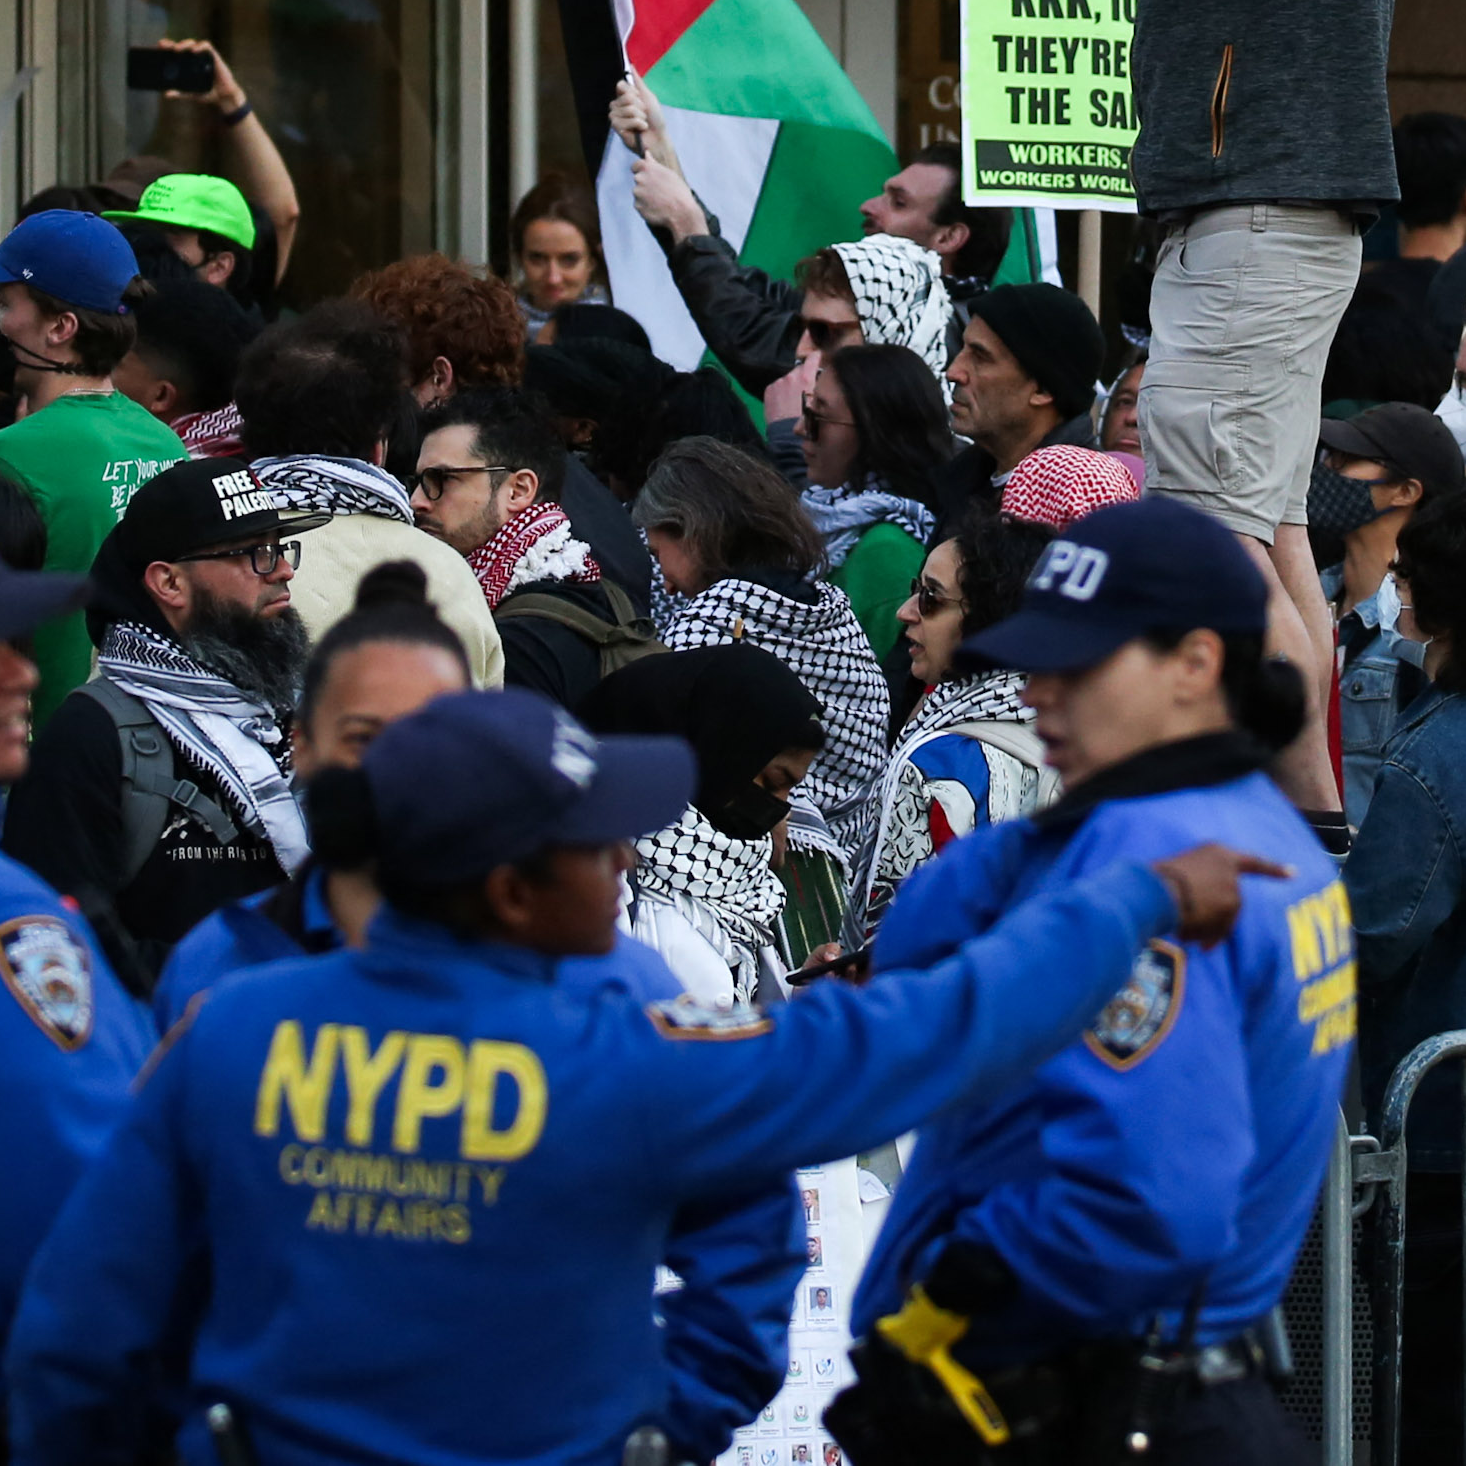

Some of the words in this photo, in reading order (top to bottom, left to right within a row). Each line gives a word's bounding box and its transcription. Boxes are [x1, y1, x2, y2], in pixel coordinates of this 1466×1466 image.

[992, 34, 1127, 78] THEY'RE
[1004, 87, 1072, 125] THE
[979, 169, 1075, 189] WORKERS
[1079, 174, 1136, 194] WORL
[102, 460, 135, 482] LET
[136, 458, 158, 481] YOUR
[212, 470, 256, 498] FREE
[1287, 880, 1353, 983] NY
[253, 1019, 549, 1161] NYPD
[278, 1145, 505, 1205] COMMUNITY
[306, 1190, 473, 1245] AFFAIRS
